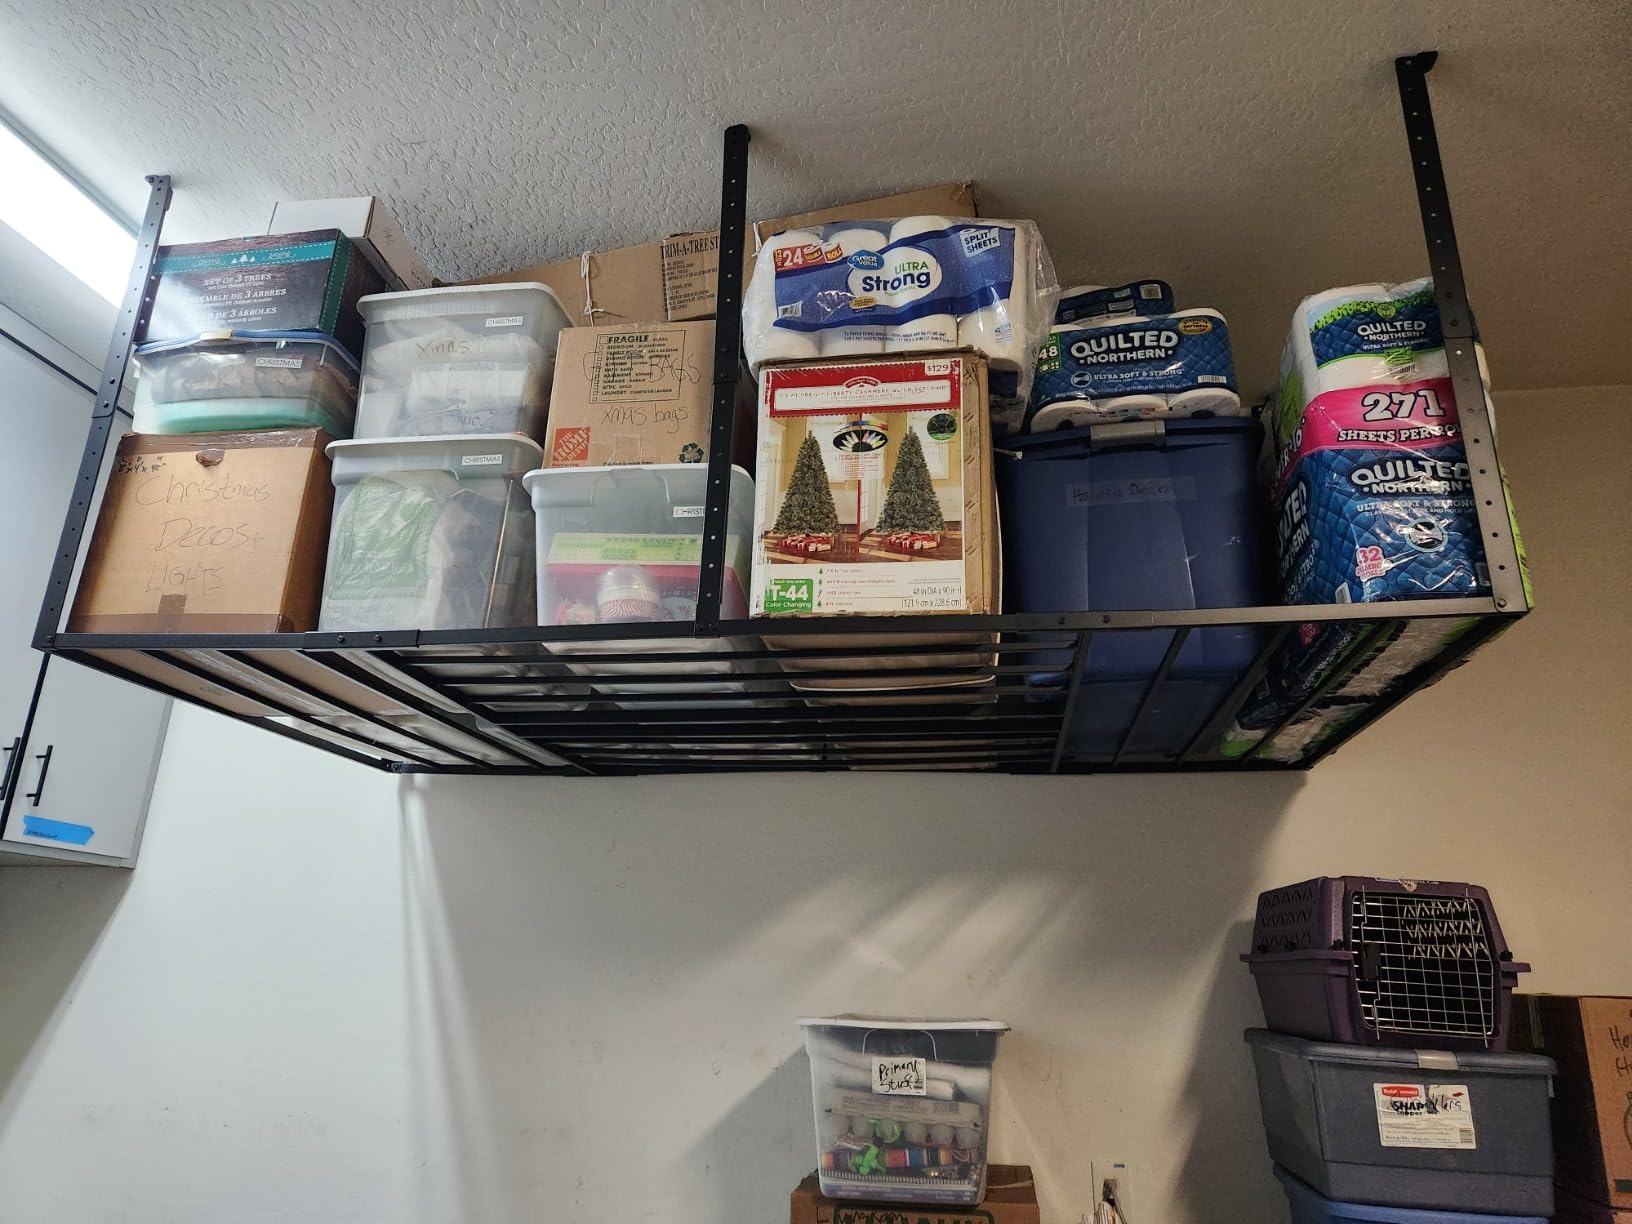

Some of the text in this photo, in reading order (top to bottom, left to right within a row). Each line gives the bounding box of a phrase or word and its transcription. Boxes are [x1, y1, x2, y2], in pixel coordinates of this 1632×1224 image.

[964, 232, 988, 245] SPLIT
[967, 237, 997, 253] SHEETS
[661, 237, 709, 259] TRIM-A-TREE
[783, 248, 803, 266] 24
[852, 255, 877, 263] Great
[895, 261, 928, 274] ULTRA
[204, 278, 221, 286] SET
[244, 274, 272, 282] TREES
[862, 271, 931, 292] Strong
[253, 289, 286, 297] ARBRES
[230, 309, 236, 317] 3
[487, 318, 522, 326] CHRISTMAS
[1357, 320, 1427, 336] QUILTED
[608, 335, 650, 344] FRAGILE
[1369, 331, 1420, 341] NORTHERN
[1070, 330, 1179, 358] QUILTED
[1039, 345, 1058, 360] 48
[1087, 348, 1165, 365] NORTHERN
[257, 359, 301, 367] CHRISTMAS
[649, 352, 701, 384] BAGS
[927, 364, 949, 372] $129
[1120, 371, 1140, 379] SOFT
[1150, 368, 1184, 377] STRONG
[1361, 389, 1446, 422] 271
[654, 403, 689, 434] bags
[1339, 430, 1396, 442] SHEETS
[1399, 428, 1430, 441] PER
[553, 428, 590, 461] HOME
[464, 456, 501, 464] CHRISTMAS
[1351, 460, 1470, 486] QUILTED
[135, 472, 271, 506] Christmas
[676, 507, 705, 516] CHRIST
[1359, 547, 1382, 563] 32
[145, 564, 225, 597] LIGHTS
[770, 585, 809, 601] T-44
[913, 588, 920, 596] 48
[927, 586, 937, 595] DIA
[943, 586, 950, 595] 90
[783, 601, 812, 609] Changing
[935, 598, 950, 607] 228.6
[879, 1059, 919, 1084] Primary
